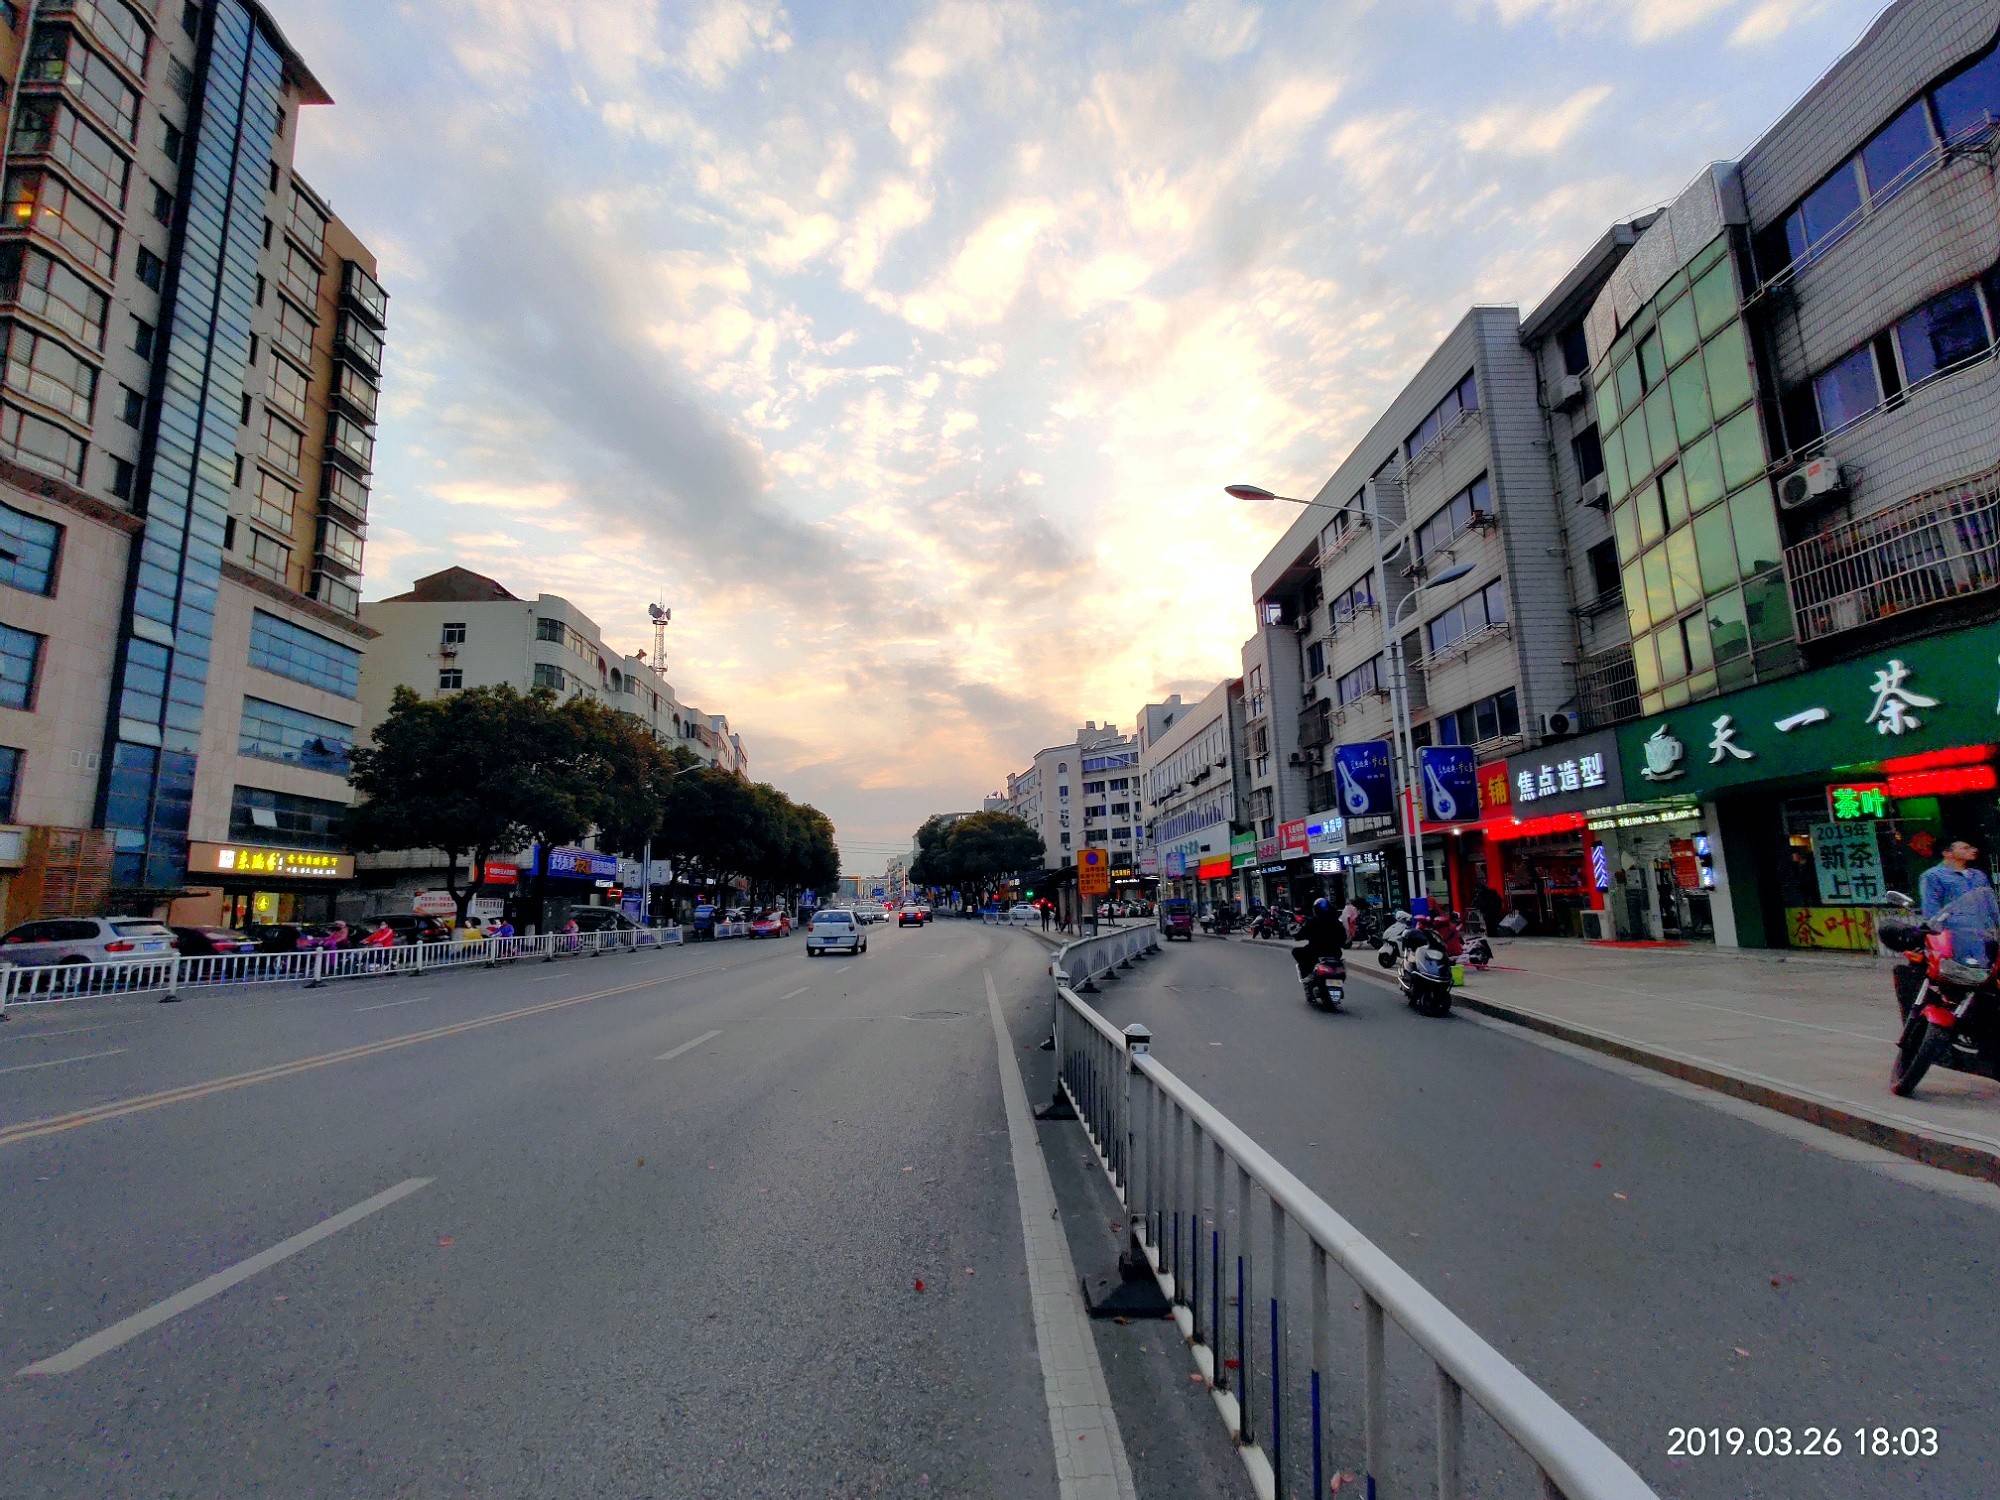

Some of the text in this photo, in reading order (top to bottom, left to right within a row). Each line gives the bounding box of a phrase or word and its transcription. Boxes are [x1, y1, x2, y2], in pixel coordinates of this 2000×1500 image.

[1708, 659, 2000, 764] 天一茶
[1517, 752, 1607, 803] 焦点造型
[1833, 787, 1885, 819] 茶叶
[1817, 822, 1870, 841] 2019年
[1820, 842, 1873, 869] 新茶
[1828, 873, 1878, 900] 上市
